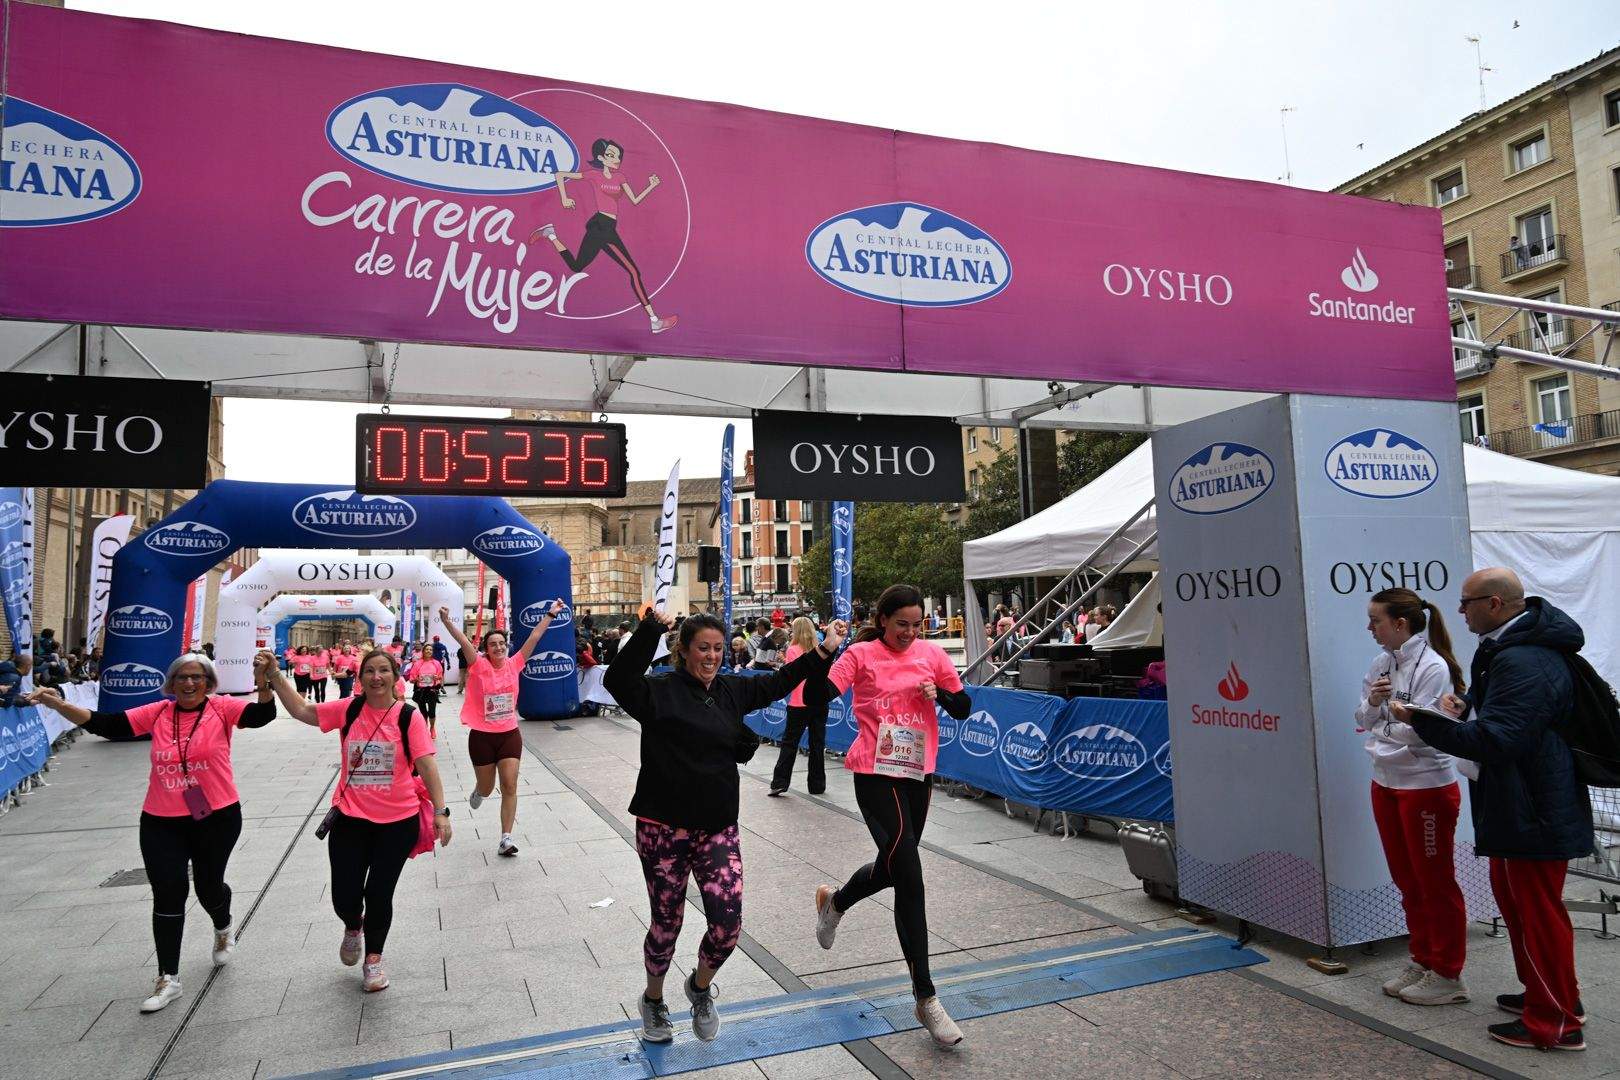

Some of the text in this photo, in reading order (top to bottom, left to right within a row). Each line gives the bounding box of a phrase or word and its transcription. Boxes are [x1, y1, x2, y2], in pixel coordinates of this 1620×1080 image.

[388, 112, 554, 144] CENTRAL LECHERA
[1, 140, 104, 161] ECHERA
[346, 111, 559, 175] ASTURIANA
[301, 171, 516, 245] Carrera
[856, 233, 991, 255] CENTRAL LECHERA
[823, 233, 998, 285] ASTURIANA
[354, 236, 591, 334] de la Mujer
[1103, 263, 1233, 306] OYSHO
[1308, 292, 1416, 324] Santander
[789, 442, 936, 476] OYSHO
[1334, 453, 1432, 481] ASTURIANA
[1350, 452, 1426, 461] CENTRAL LECHERA
[1189, 459, 1261, 480] CENTRAL LECHERA
[1176, 469, 1267, 503] ASTURIANA
[302, 503, 408, 526] ASTURIANA
[149, 532, 223, 548] ASTURIANA
[480, 538, 540, 550] ASTURIANA
[297, 562, 394, 581] OYSHO
[1330, 560, 1449, 594] OYSHO
[1175, 565, 1281, 602] OYSHO
[109, 616, 168, 630] ASTURIANA
[220, 620, 250, 628] OYSHO
[102, 674, 160, 687] ASTURIANA
[874, 697, 890, 710] TU
[1191, 704, 1280, 732] Santander
[155, 751, 173, 761] TU
[364, 757, 381, 766] 016
[895, 745, 912, 755] 016
[1059, 743, 1139, 768] ASTURIANA
